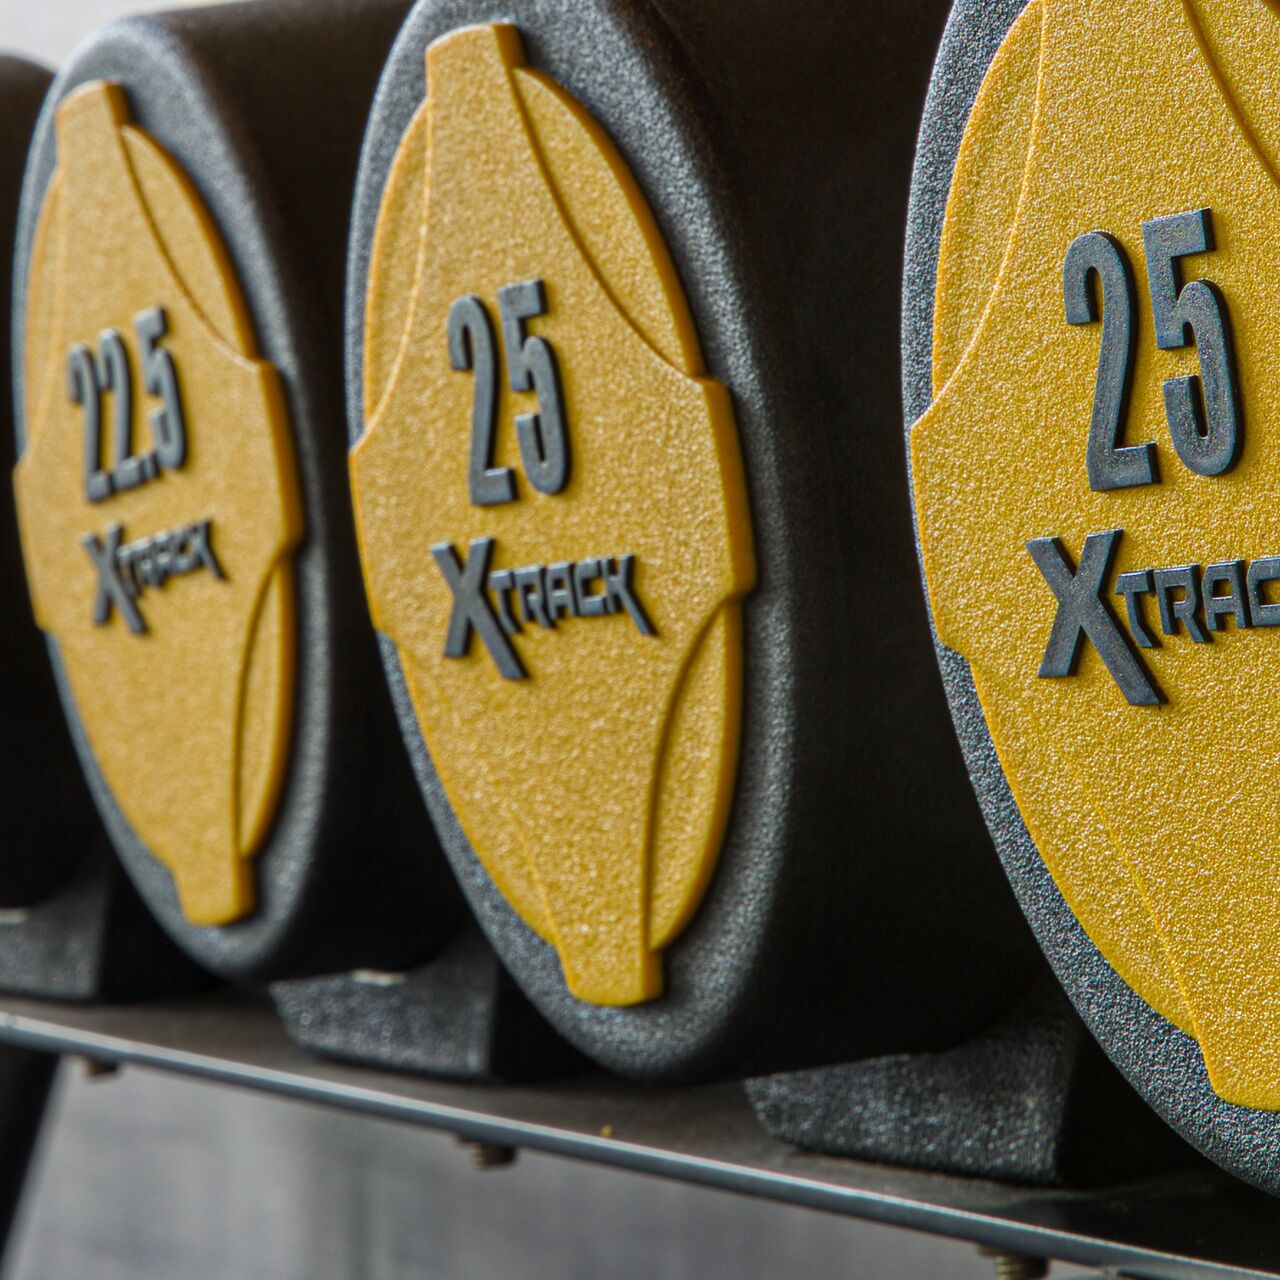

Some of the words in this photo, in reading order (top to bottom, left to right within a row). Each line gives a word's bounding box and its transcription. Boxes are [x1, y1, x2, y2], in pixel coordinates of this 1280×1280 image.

[67, 307, 186, 504] 22.5
[447, 278, 571, 506] 25
[1062, 207, 1244, 492] 25
[81, 517, 231, 637] XTRACK
[428, 536, 660, 681] XTRACK
